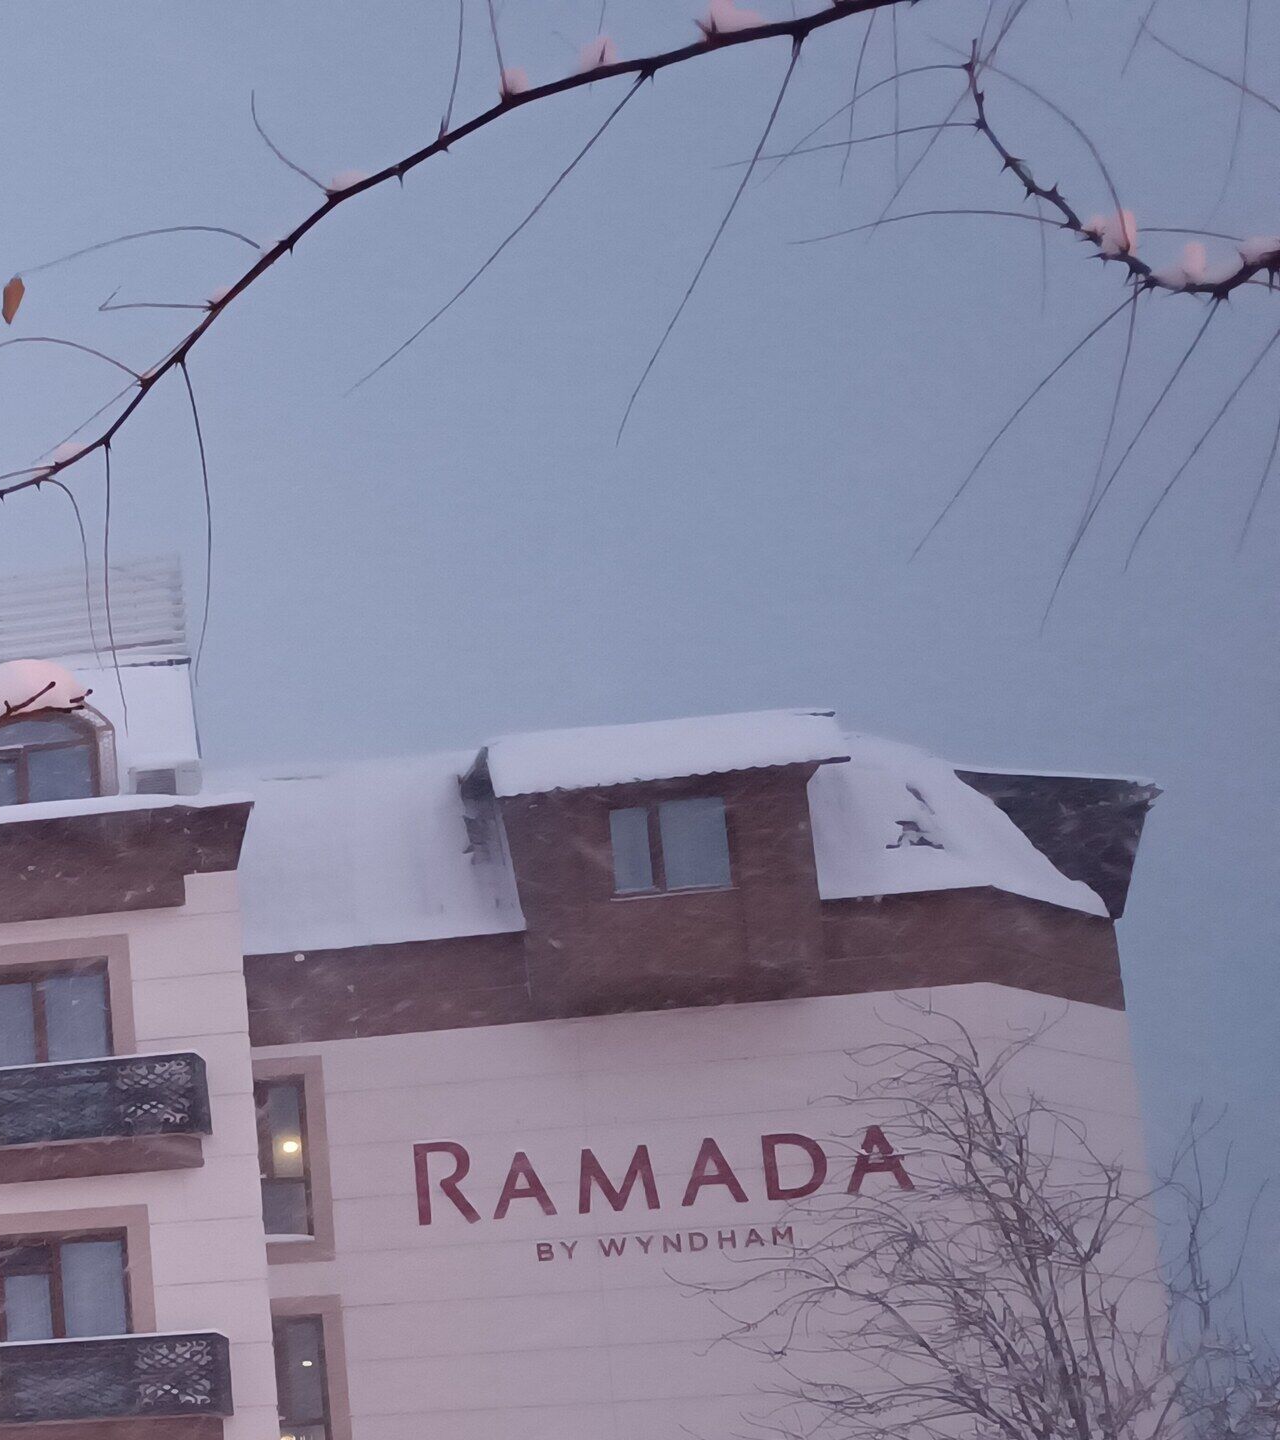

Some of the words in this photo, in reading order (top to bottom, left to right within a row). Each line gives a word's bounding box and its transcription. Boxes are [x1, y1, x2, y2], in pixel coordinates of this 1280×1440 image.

[413, 1125, 915, 1226] RAMADA
[536, 1240, 578, 1262] BY
[598, 1225, 795, 1258] WYNDHAM
